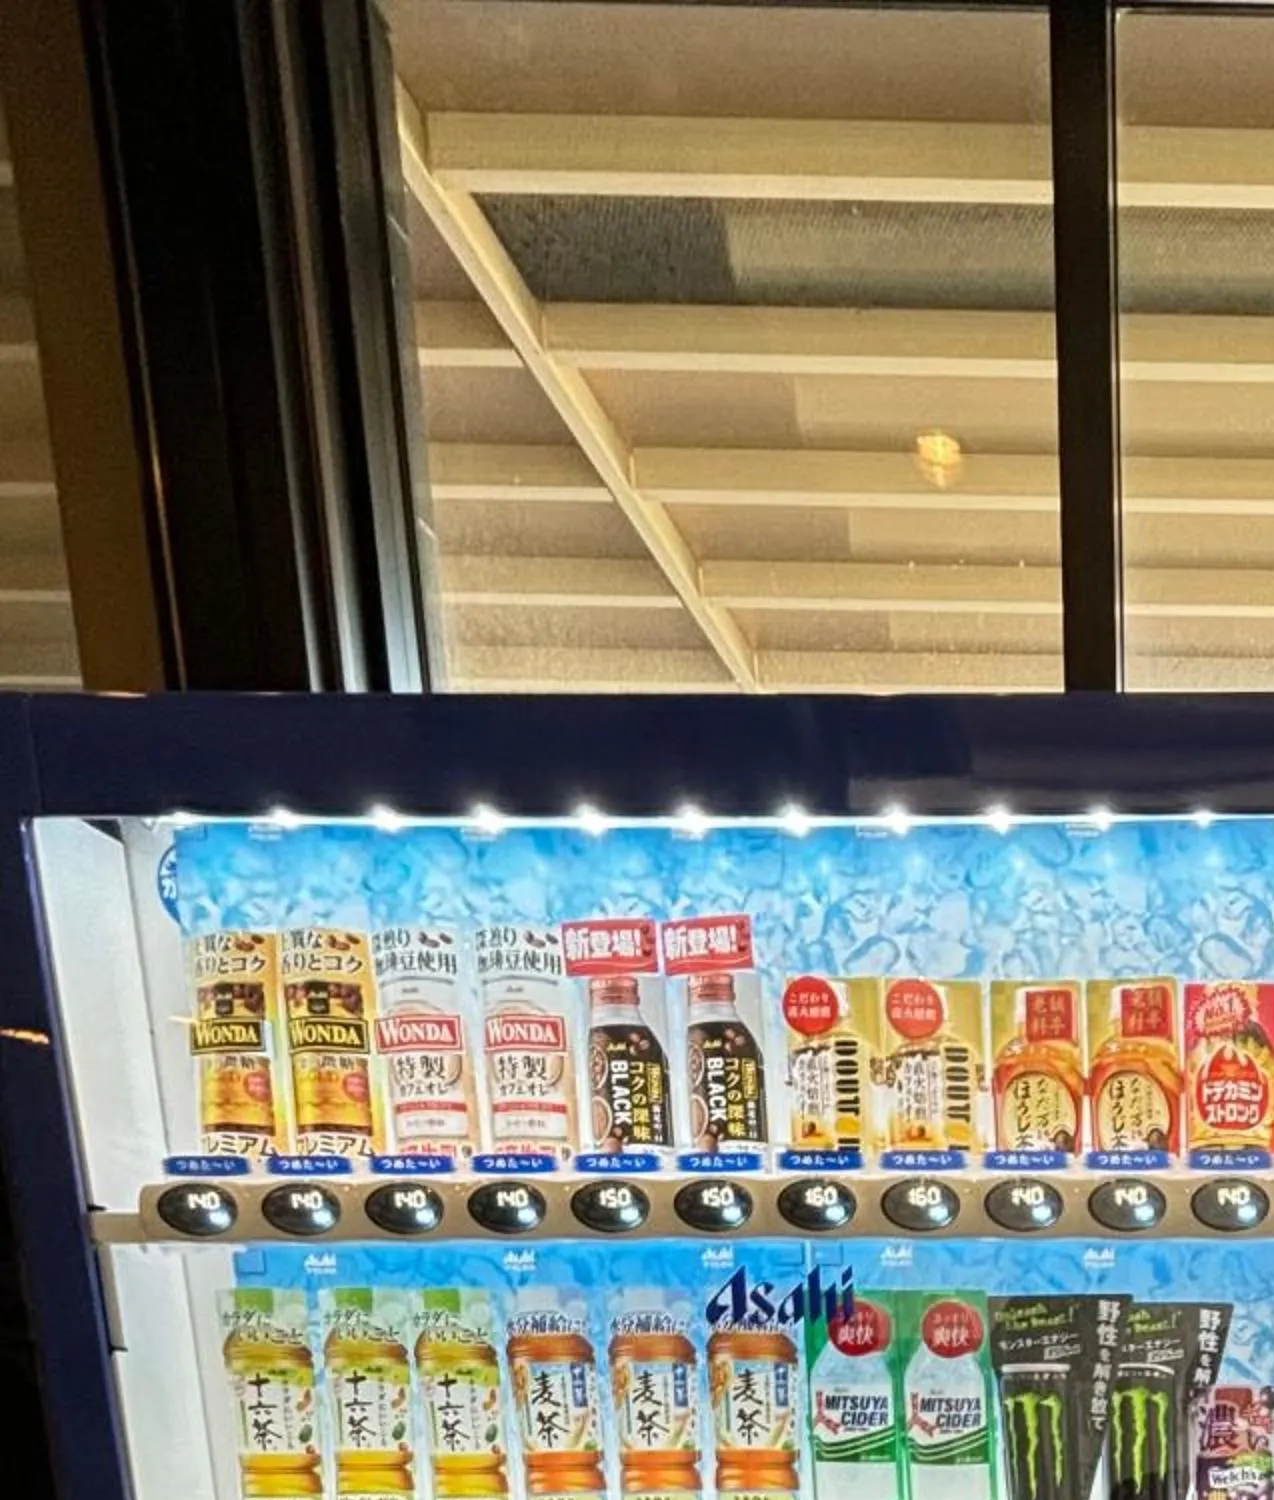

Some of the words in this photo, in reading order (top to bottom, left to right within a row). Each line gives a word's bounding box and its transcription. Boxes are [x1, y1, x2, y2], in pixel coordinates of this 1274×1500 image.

[564, 926, 641, 961] 新登場!
[664, 924, 738, 960] 新登場!
[194, 1020, 260, 1046] WONDA
[291, 1019, 361, 1046] WONDA
[379, 1018, 455, 1046] WONDA
[487, 1018, 557, 1046] WONDA
[396, 1055, 446, 1079] 特製
[498, 1055, 548, 1079] 特製
[610, 1059, 633, 1125] BLACK
[706, 1056, 727, 1122] BLACK
[1205, 1103, 1260, 1123] ストロング
[188, 1191, 220, 1210] 140
[291, 1191, 323, 1210] 140
[394, 1189, 426, 1209] 140
[496, 1189, 529, 1208] 140
[600, 1187, 631, 1208] 150
[702, 1187, 733, 1208] 150
[804, 1186, 838, 1206] 160
[907, 1186, 941, 1206] 160
[1011, 1186, 1044, 1206] 140
[1114, 1186, 1147, 1206] 140
[1217, 1186, 1250, 1206] 140
[704, 1264, 854, 1327] Asahi
[837, 1323, 874, 1346] 爽快
[932, 1324, 969, 1347] 爽快
[1090, 1301, 1122, 1432] 野性を解き放て
[247, 1373, 282, 1452] 十六茶
[344, 1370, 377, 1451] 十六茶
[437, 1373, 470, 1452] 十六茶
[531, 1373, 569, 1448] 麦茶
[633, 1371, 670, 1446] 麦茶
[733, 1370, 770, 1446] 麦茶
[825, 1395, 889, 1411] MITSUYA
[919, 1396, 981, 1412] MITSUYA
[841, 1411, 889, 1426] CIDER
[936, 1413, 981, 1428] CIDER
